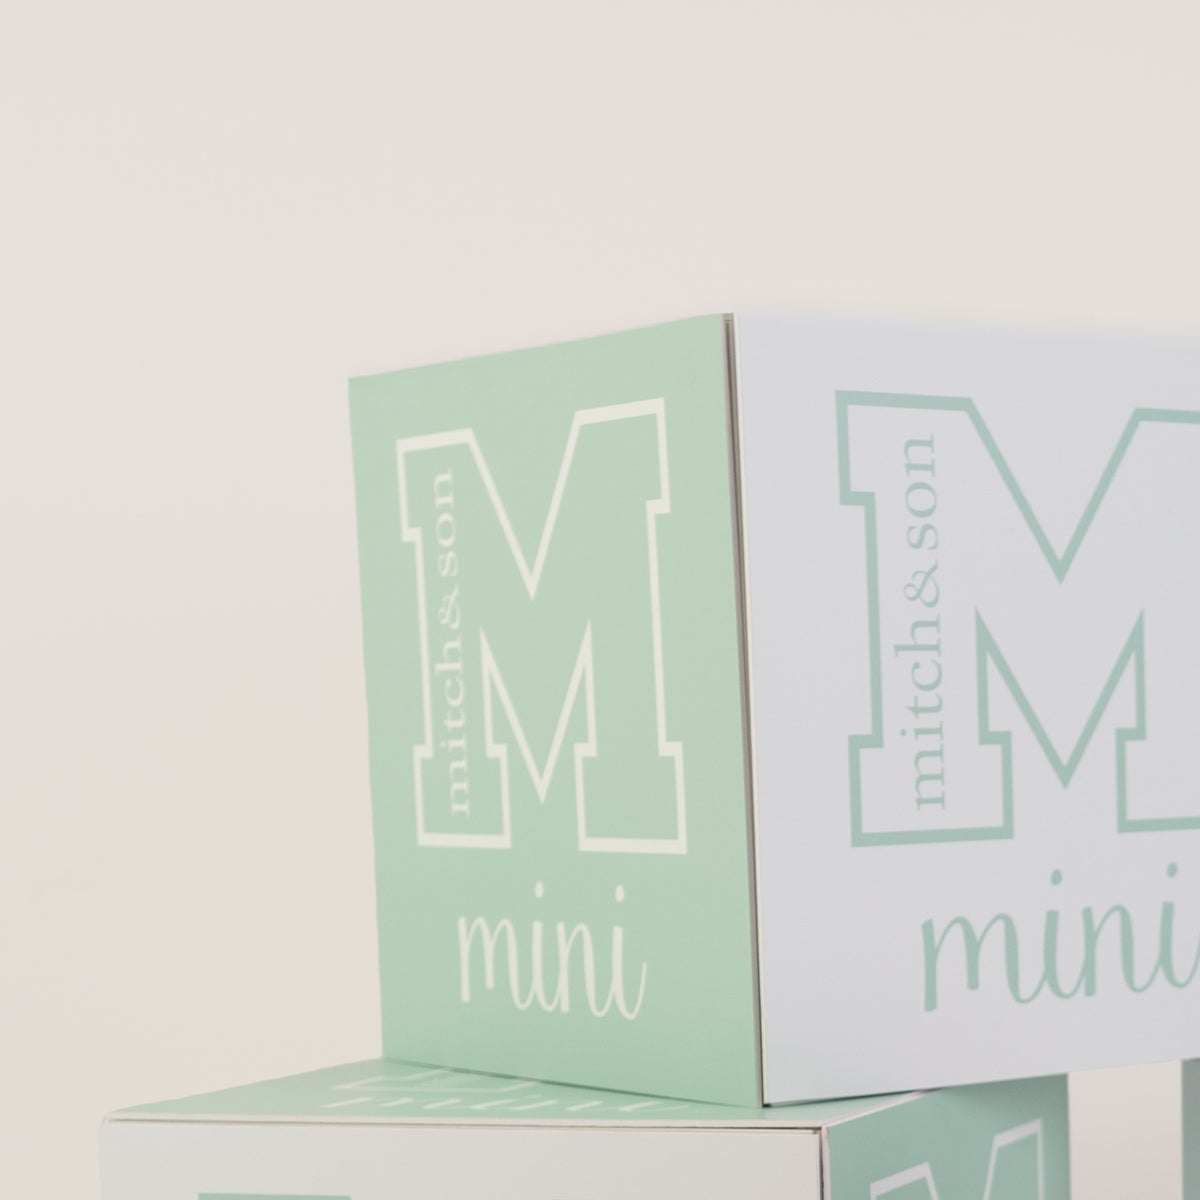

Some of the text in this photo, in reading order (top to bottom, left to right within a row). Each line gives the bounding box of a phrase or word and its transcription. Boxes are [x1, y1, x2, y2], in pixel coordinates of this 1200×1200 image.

[396, 397, 689, 855] M
[433, 468, 468, 816] mitch&son
[893, 433, 945, 812] mitch&son
[457, 881, 648, 1020] mini
